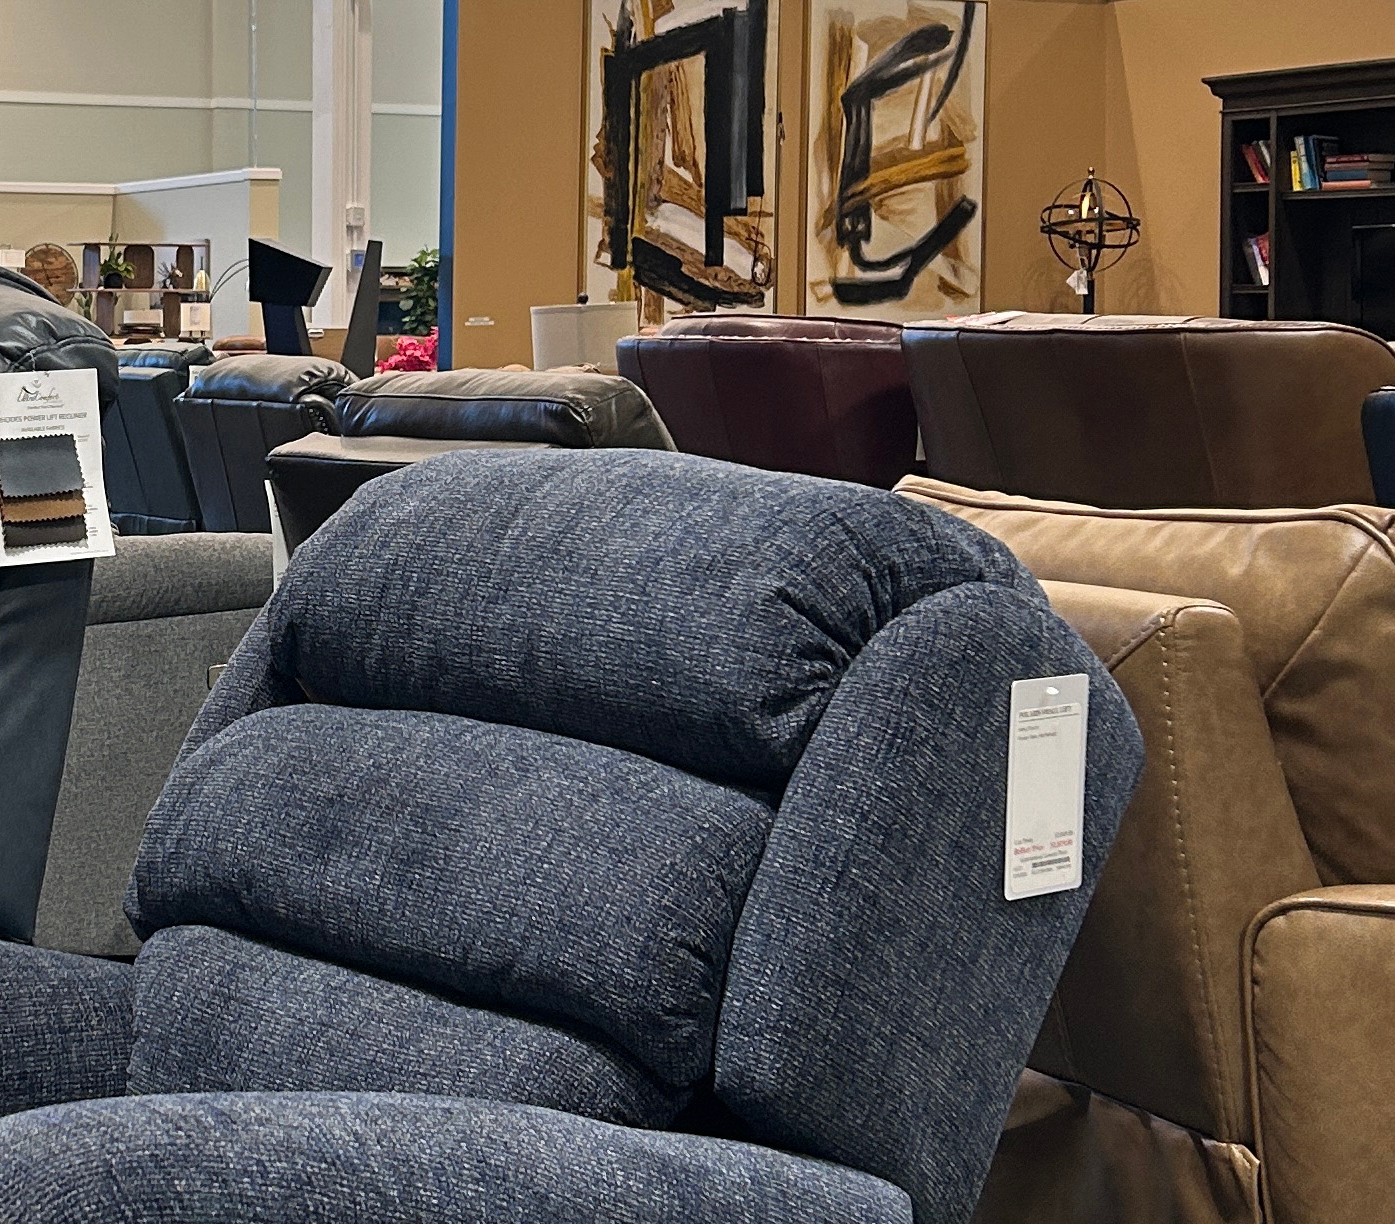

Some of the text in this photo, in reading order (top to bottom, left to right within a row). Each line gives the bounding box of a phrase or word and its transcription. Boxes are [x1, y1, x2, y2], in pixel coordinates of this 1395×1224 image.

[24, 414, 46, 422] POWER
[46, 413, 58, 421] LIFT
[59, 412, 87, 420] RECLINER
